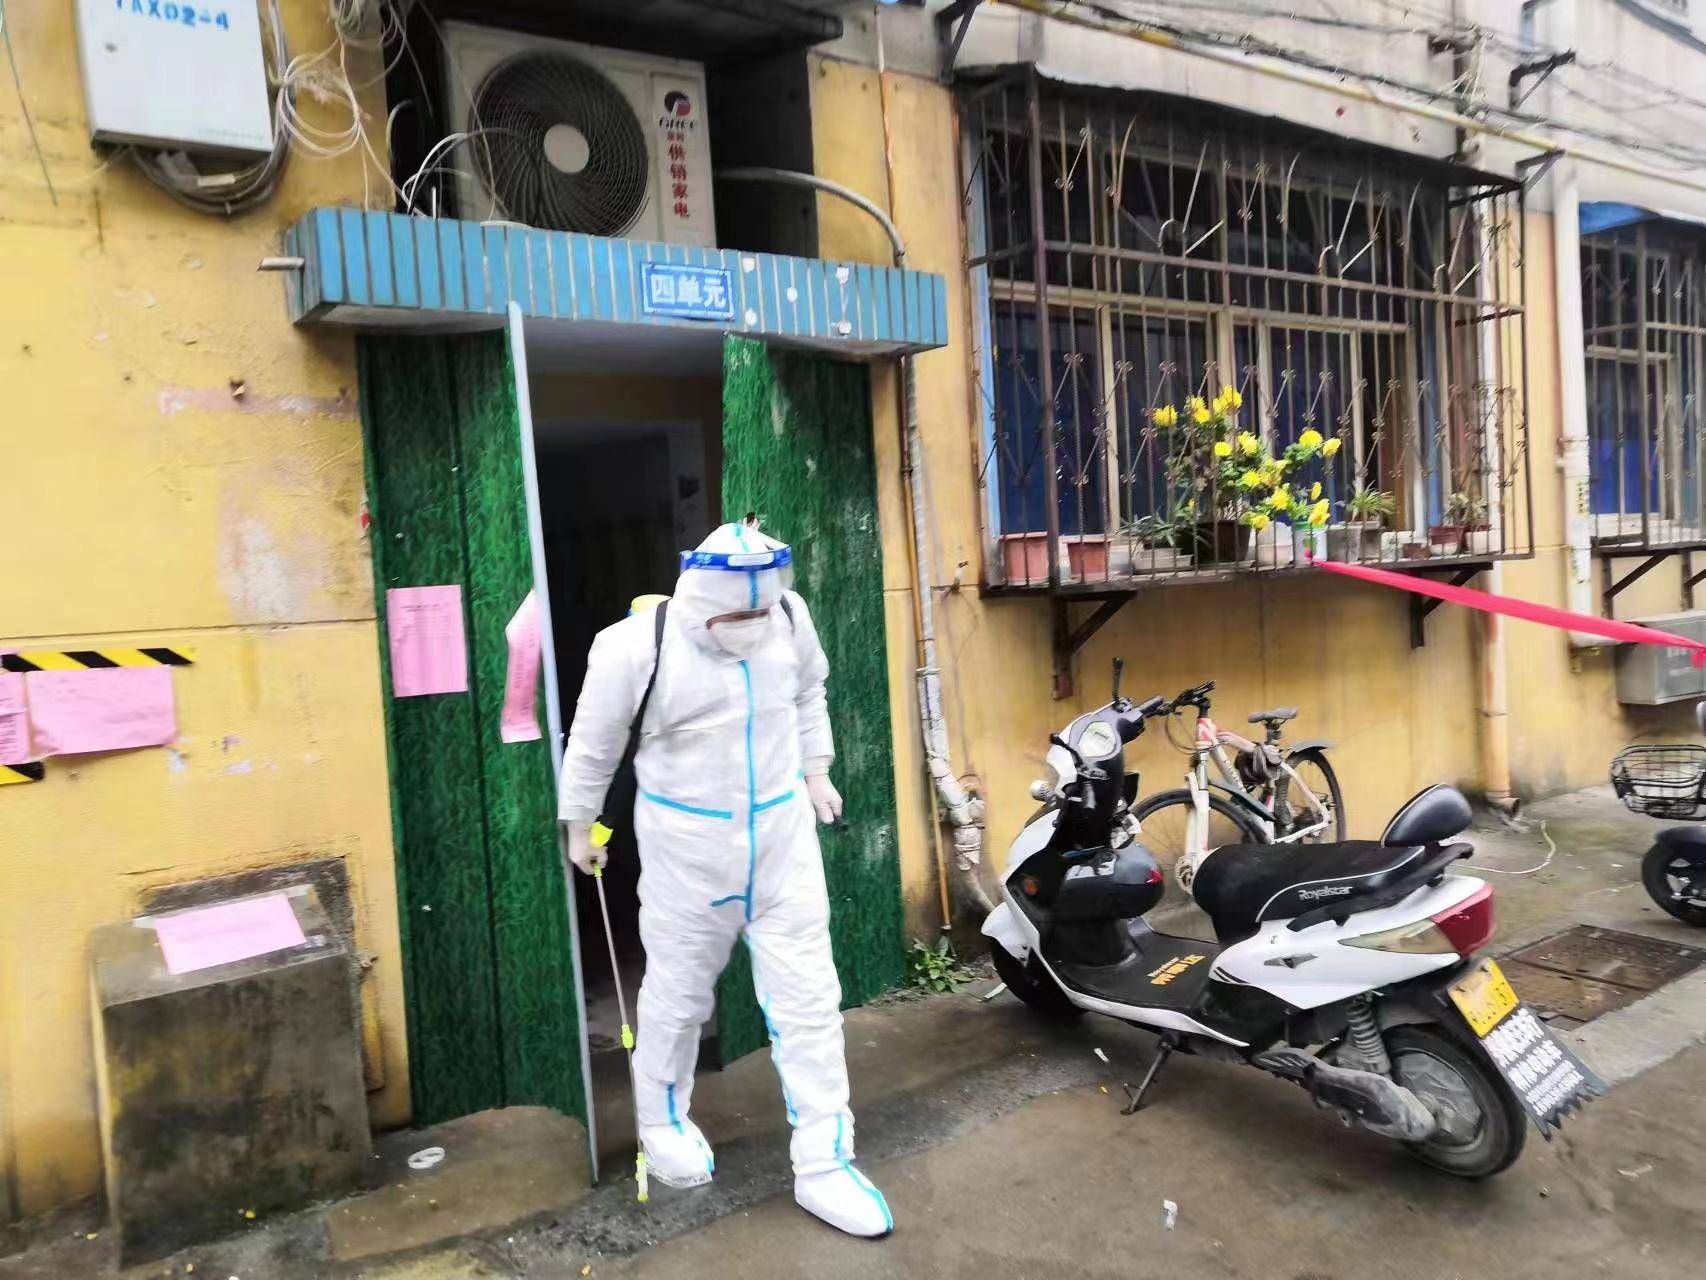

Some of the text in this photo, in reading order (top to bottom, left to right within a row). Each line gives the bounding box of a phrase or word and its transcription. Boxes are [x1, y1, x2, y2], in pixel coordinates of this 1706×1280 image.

[650, 272, 727, 309] 四单元
[1297, 886, 1354, 901] Royalstar
